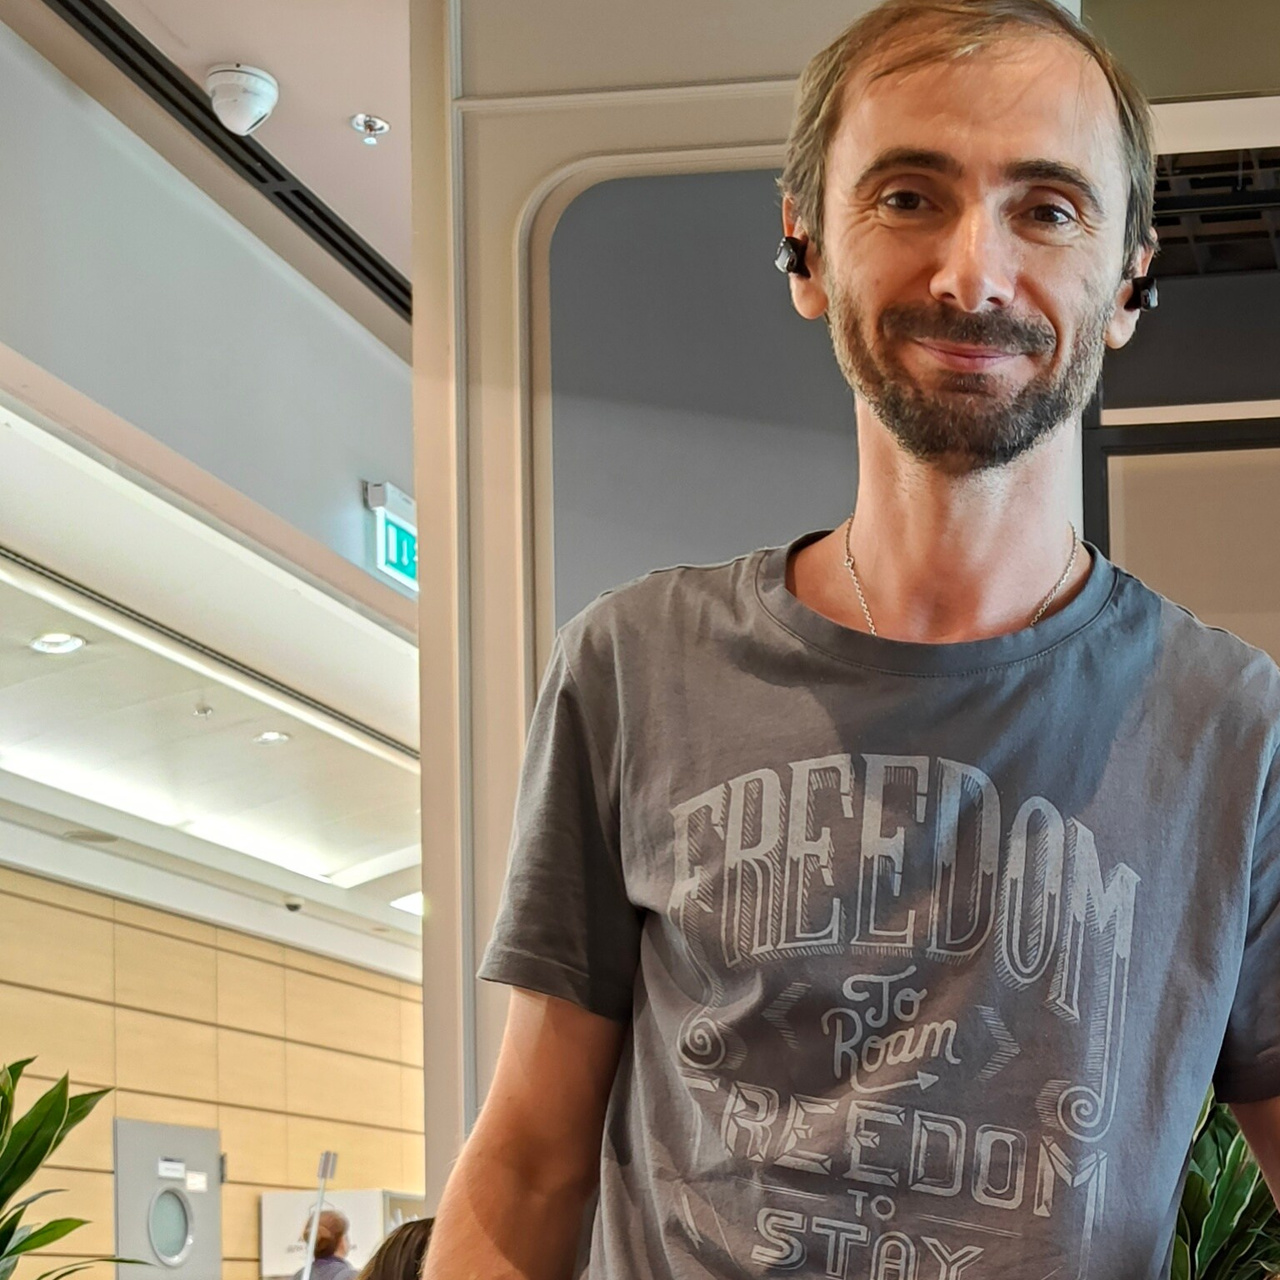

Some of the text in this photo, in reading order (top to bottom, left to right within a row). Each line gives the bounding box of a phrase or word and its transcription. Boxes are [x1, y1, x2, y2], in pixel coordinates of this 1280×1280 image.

[668, 753, 1141, 1023] FREEDOM
[843, 966, 926, 1027] To
[821, 1004, 962, 1080] Roam
[847, 1189, 896, 1221] TO
